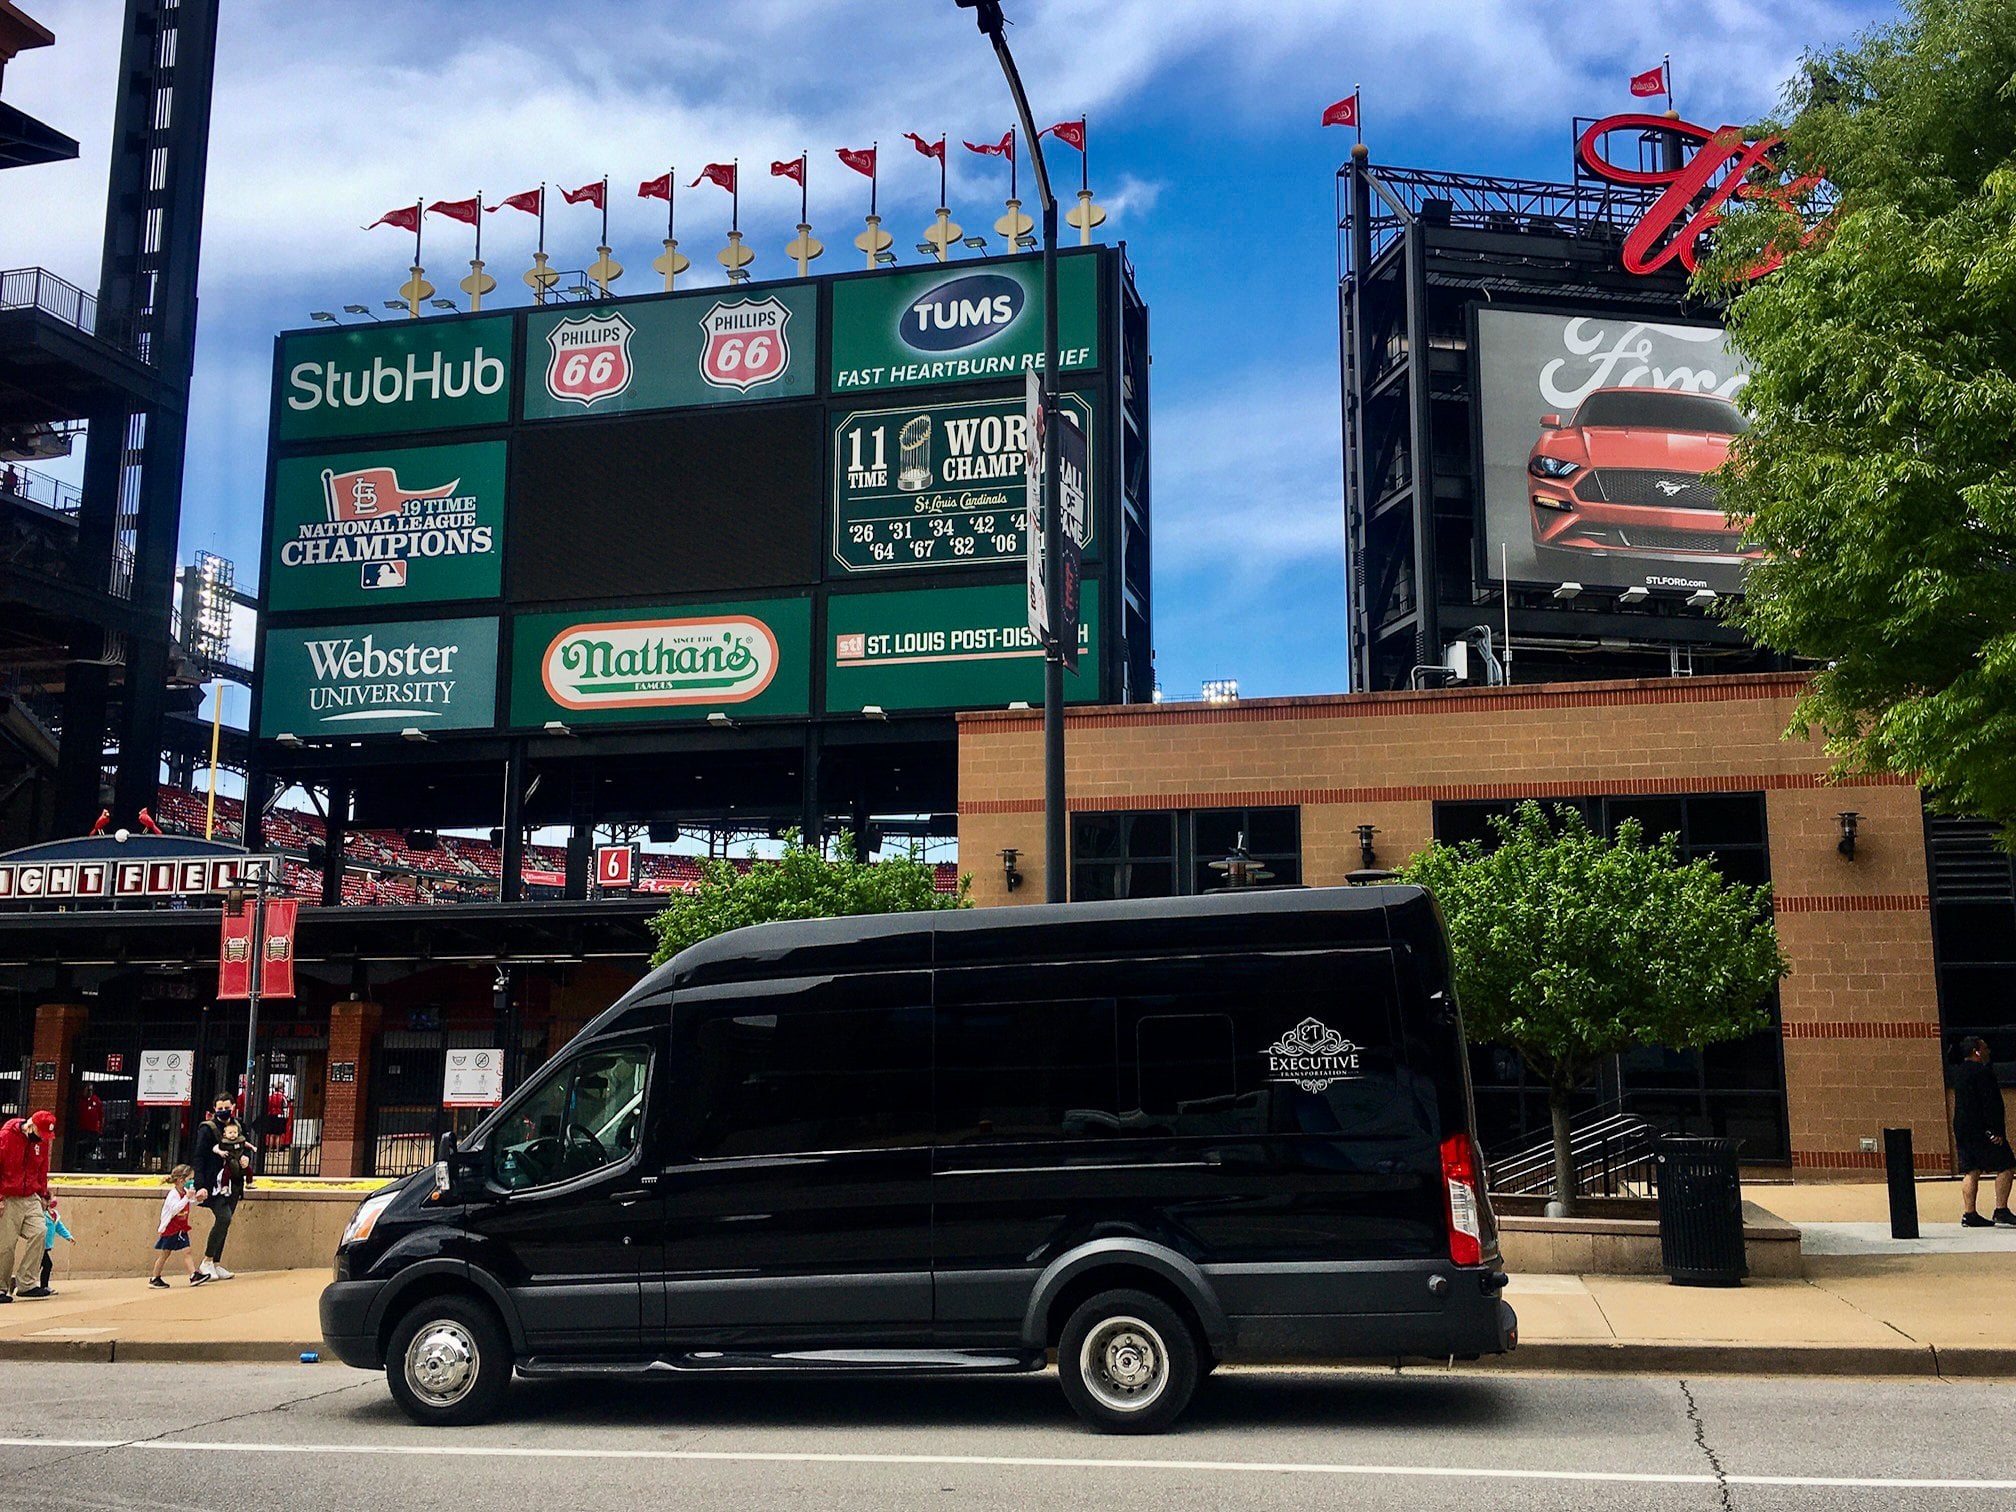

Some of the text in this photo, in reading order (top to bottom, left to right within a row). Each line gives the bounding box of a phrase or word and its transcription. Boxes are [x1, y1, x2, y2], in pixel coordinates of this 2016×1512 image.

[715, 311, 776, 331] PHILLIPS
[913, 295, 1013, 331] TUMS
[561, 327, 620, 346] PHILLIPS
[562, 351, 615, 386] 66
[717, 336, 772, 372] 66
[837, 348, 1090, 387] FAST HEARTBURN REIEF
[288, 346, 505, 411] StubHub
[848, 426, 888, 473] 11
[848, 449, 1045, 489] TIME CHAMP
[402, 496, 476, 517] 19 TIME
[960, 492, 1007, 509] Cardinals
[299, 512, 476, 539] NATIONAL LEAGUE
[281, 526, 493, 567] CHAMPIONS
[1645, 576, 1707, 588] STLFORD.com
[868, 635, 892, 655] ST.
[895, 631, 945, 654] LOUIS
[951, 624, 1088, 650] POST-DISH
[304, 634, 458, 681] Webster
[562, 631, 755, 679] Nathan's
[310, 681, 456, 711] UNIVERSITY
[634, 680, 673, 691] FAMOUS
[608, 851, 620, 878] 6
[1269, 1054, 1360, 1071] EXECUTIVE
[1280, 1069, 1347, 1077] TRANSPORTATION
